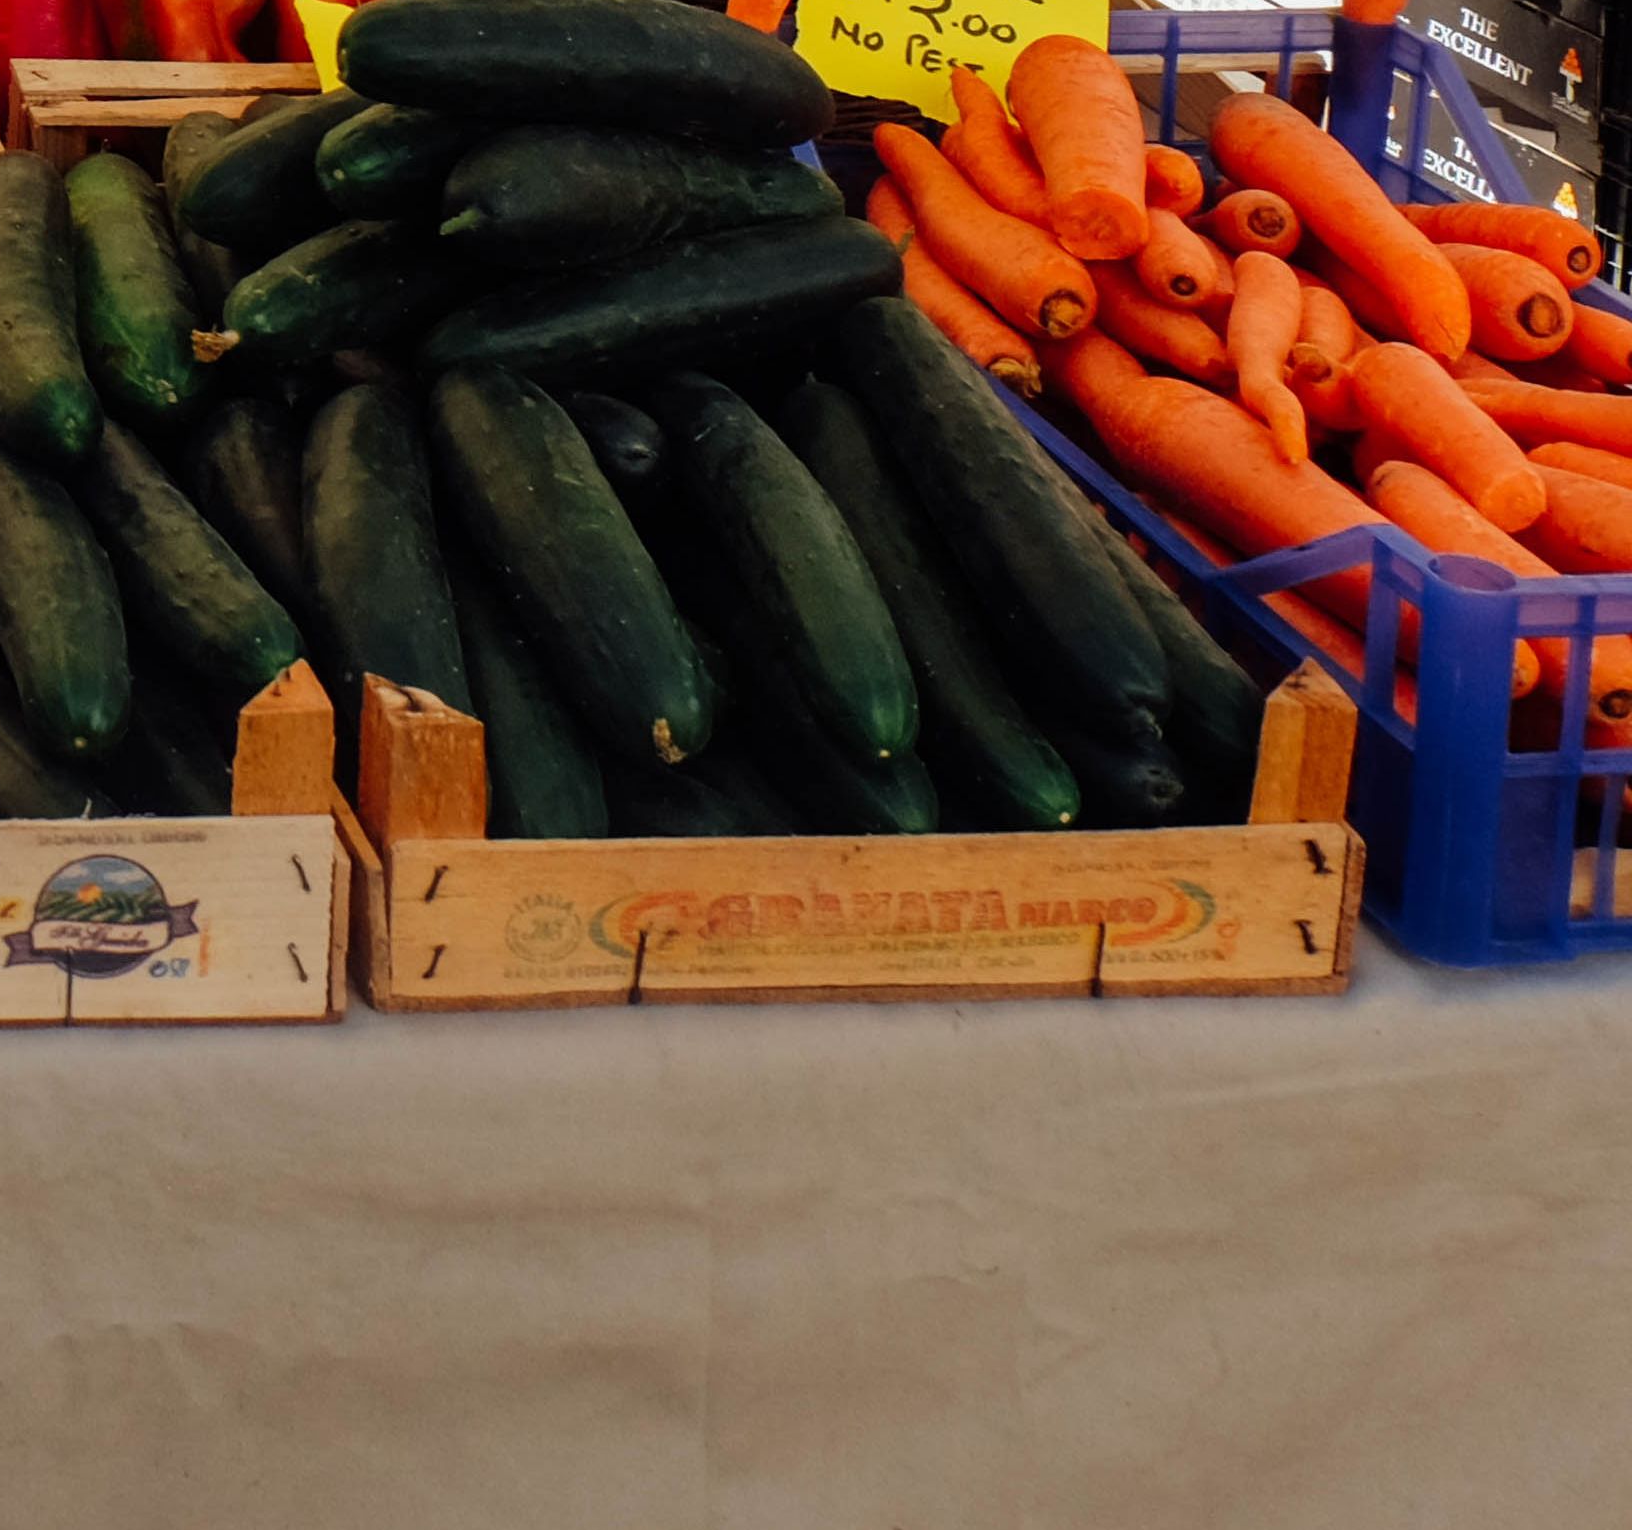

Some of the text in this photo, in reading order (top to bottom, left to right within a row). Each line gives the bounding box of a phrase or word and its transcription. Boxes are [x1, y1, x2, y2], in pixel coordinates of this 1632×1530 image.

[831, 15, 885, 52] NO
[1460, 7, 1500, 42] THE
[1427, 19, 1533, 87] EXCELLENT
[1018, 896, 1159, 928] MARCO
